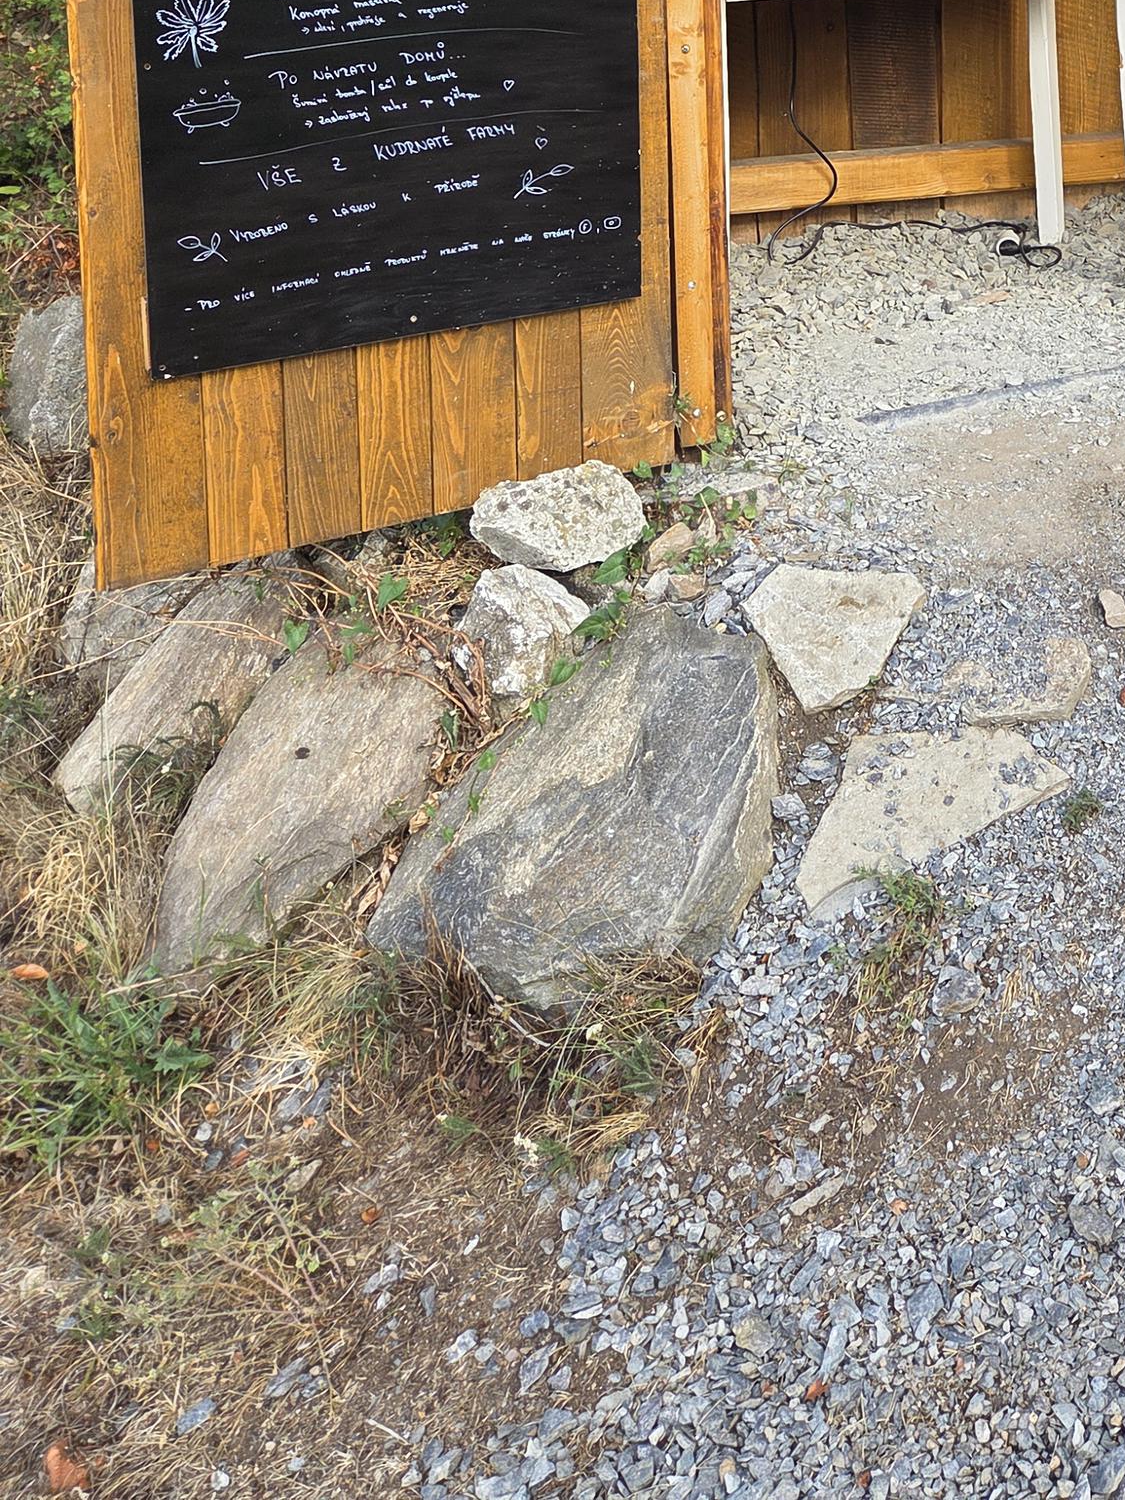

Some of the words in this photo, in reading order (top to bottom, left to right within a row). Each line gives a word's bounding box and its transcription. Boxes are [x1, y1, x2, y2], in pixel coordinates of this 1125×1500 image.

[288, 4, 341, 22] Konopná
[397, 11, 408, 19] a
[313, 61, 378, 81] NÁVRATU
[256, 163, 304, 191] VŠE
[373, 125, 455, 162] KUDRNATÉ
[466, 123, 516, 142] FARMY
[229, 222, 289, 243] VYROBENO
[306, 213, 319, 224] S
[331, 201, 378, 219] LÁSKOU
[433, 173, 481, 194] PŘÍRODĚ
[196, 299, 222, 311] PRO
[234, 286, 256, 302] VÍCE
[271, 272, 321, 294] INFORMACÍ
